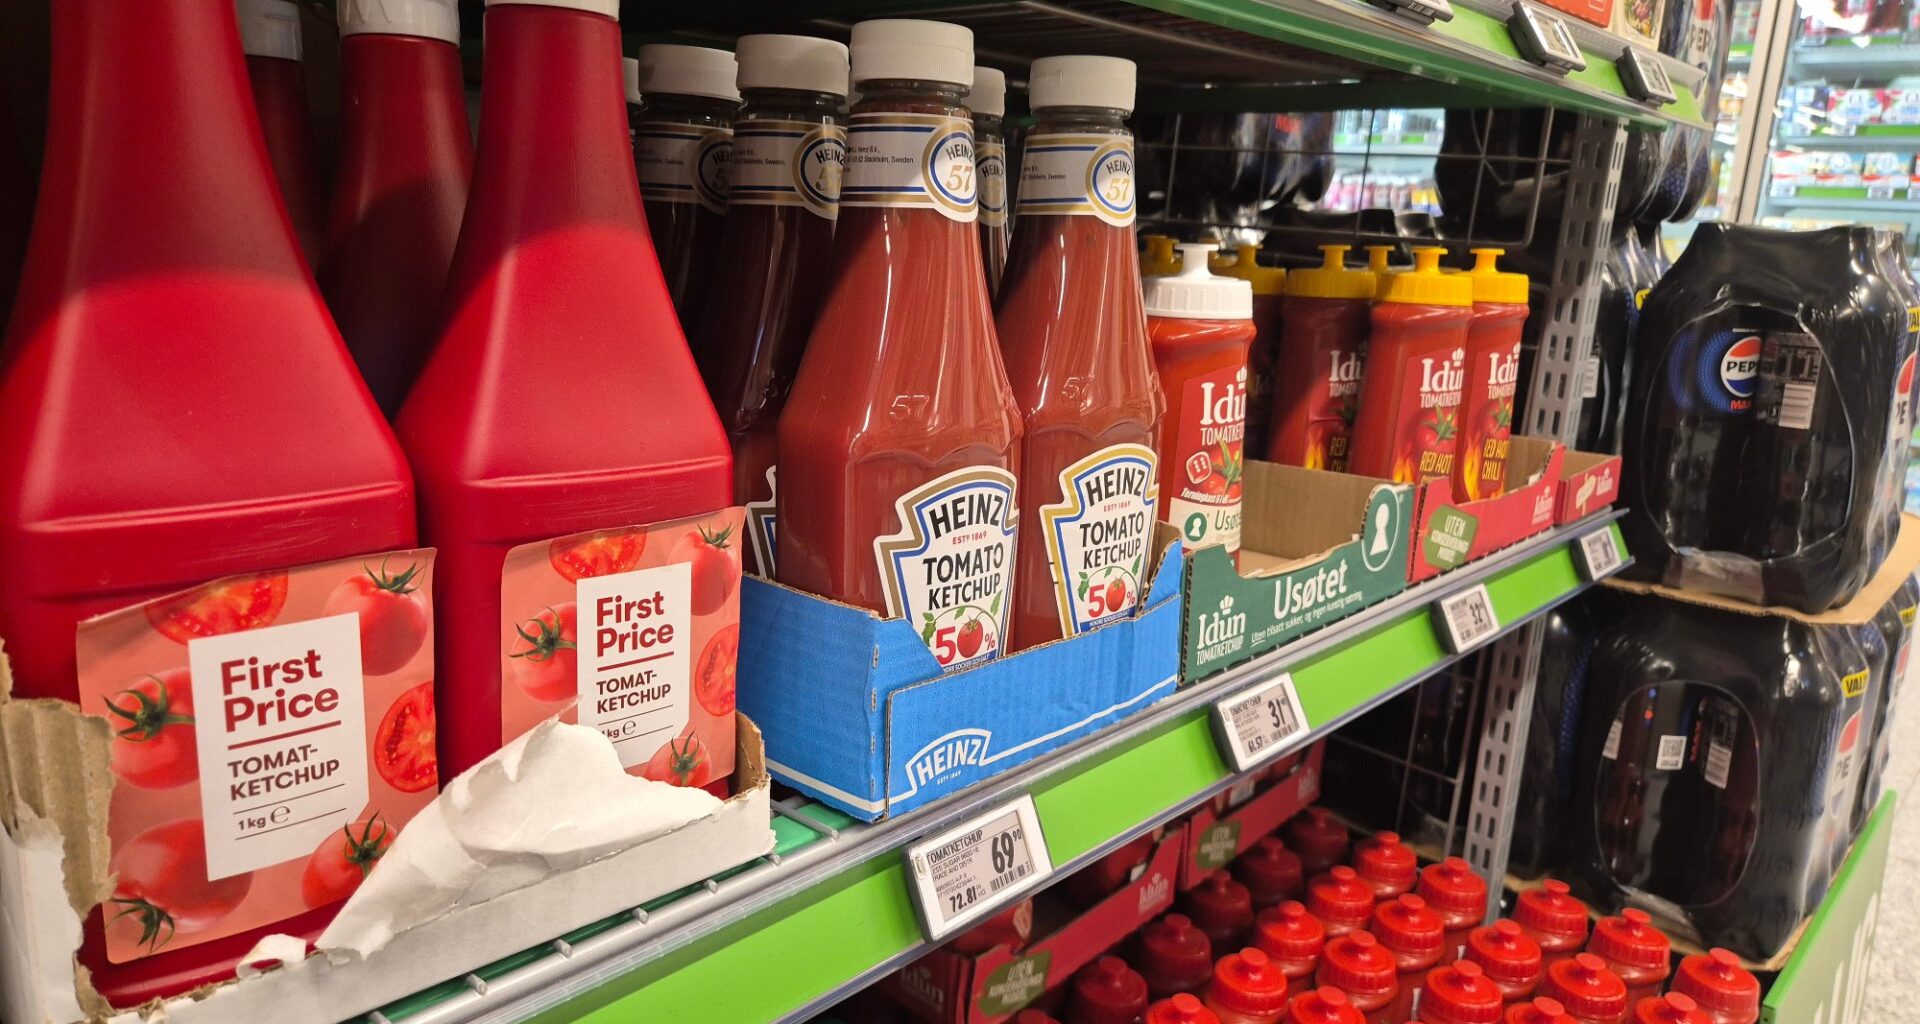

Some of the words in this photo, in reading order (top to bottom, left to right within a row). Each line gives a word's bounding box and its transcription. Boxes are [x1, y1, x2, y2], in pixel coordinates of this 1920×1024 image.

[946, 144, 972, 162] HEINZ
[1106, 160, 1131, 176] HEINZ
[946, 165, 973, 193] 57
[1106, 178, 1131, 202] 57
[1420, 357, 1464, 392] Idu
[1488, 352, 1519, 385] Idu
[1200, 382, 1246, 425] Idu
[1420, 450, 1436, 472] RED
[1436, 452, 1454, 474] HOT
[1482, 460, 1502, 480] CHILI
[1085, 467, 1145, 506] HEINZ
[928, 493, 1004, 540] HEINZ
[1080, 510, 1144, 548] TOMATO
[923, 542, 1004, 586] TOMATO
[1083, 538, 1142, 570] KETCHUP
[928, 572, 1000, 611] KETCHUP
[1274, 558, 1348, 620] Usøtet
[596, 590, 664, 626] First
[596, 622, 674, 658] Price
[1196, 611, 1246, 650] Idun
[1196, 634, 1244, 667] TOMATKETCHUP
[220, 648, 322, 696] First
[596, 670, 658, 695] TOMAT-
[224, 687, 340, 733] Price
[597, 684, 672, 714] KETCHUP
[1268, 698, 1286, 728] 31
[228, 744, 318, 779] TOMAT-
[916, 738, 982, 786] HEINZ
[230, 758, 340, 802] KETCHUP
[248, 815, 266, 830] kg
[992, 832, 1014, 874] 69
[1012, 829, 1022, 842] 90
[949, 886, 977, 912] 72.81
